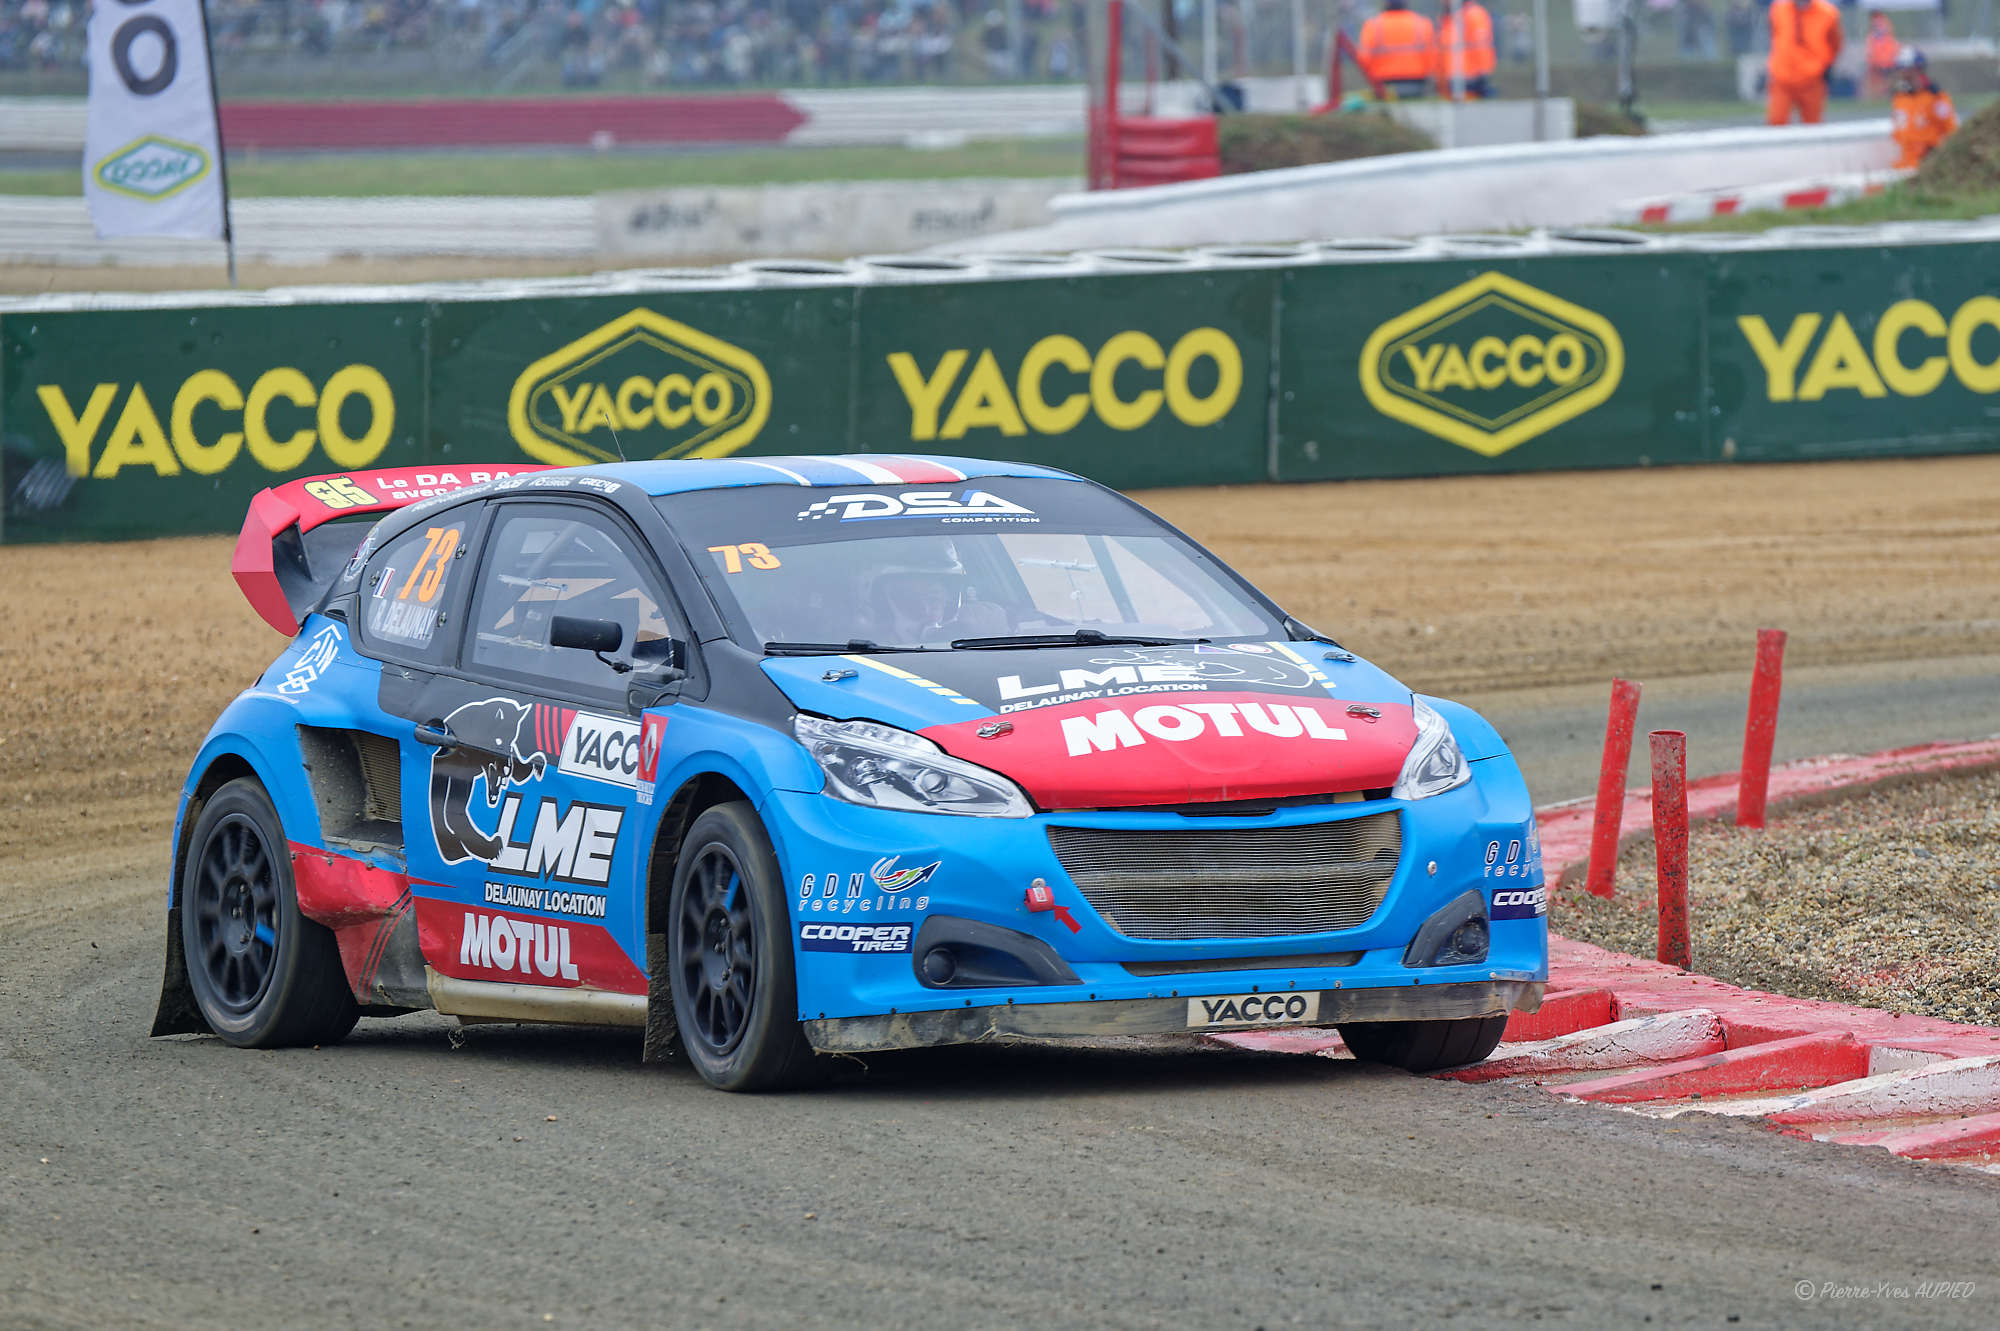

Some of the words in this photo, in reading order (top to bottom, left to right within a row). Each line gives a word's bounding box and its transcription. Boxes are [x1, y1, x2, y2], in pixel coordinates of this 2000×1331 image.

[111, 2, 178, 97] O
[1403, 332, 1586, 391] YACCO
[886, 326, 1243, 441] YACCO
[36, 363, 396, 478] YACCO
[551, 371, 734, 434] YACCO
[377, 477, 408, 490] Le
[416, 472, 461, 486] DA
[470, 471, 528, 484] RA
[826, 489, 1036, 519] DSA
[398, 527, 460, 603] 73
[707, 542, 781, 574] 73
[997, 664, 1200, 700] LME
[1000, 689, 1103, 715] DELAUNAY
[1107, 682, 1208, 697] LOCATION
[1060, 702, 1348, 757] MOTUL
[488, 795, 625, 885] LME
[800, 873, 865, 899] GDN
[1484, 863, 1535, 878] recy
[485, 882, 544, 910] DELAUNAY
[544, 889, 607, 918] LOCATION
[798, 896, 930, 914] recycling
[460, 912, 580, 982] MOTUL
[801, 924, 912, 941] COOPER
[852, 940, 908, 952] TIRES
[1201, 994, 1307, 1023] YACCO
